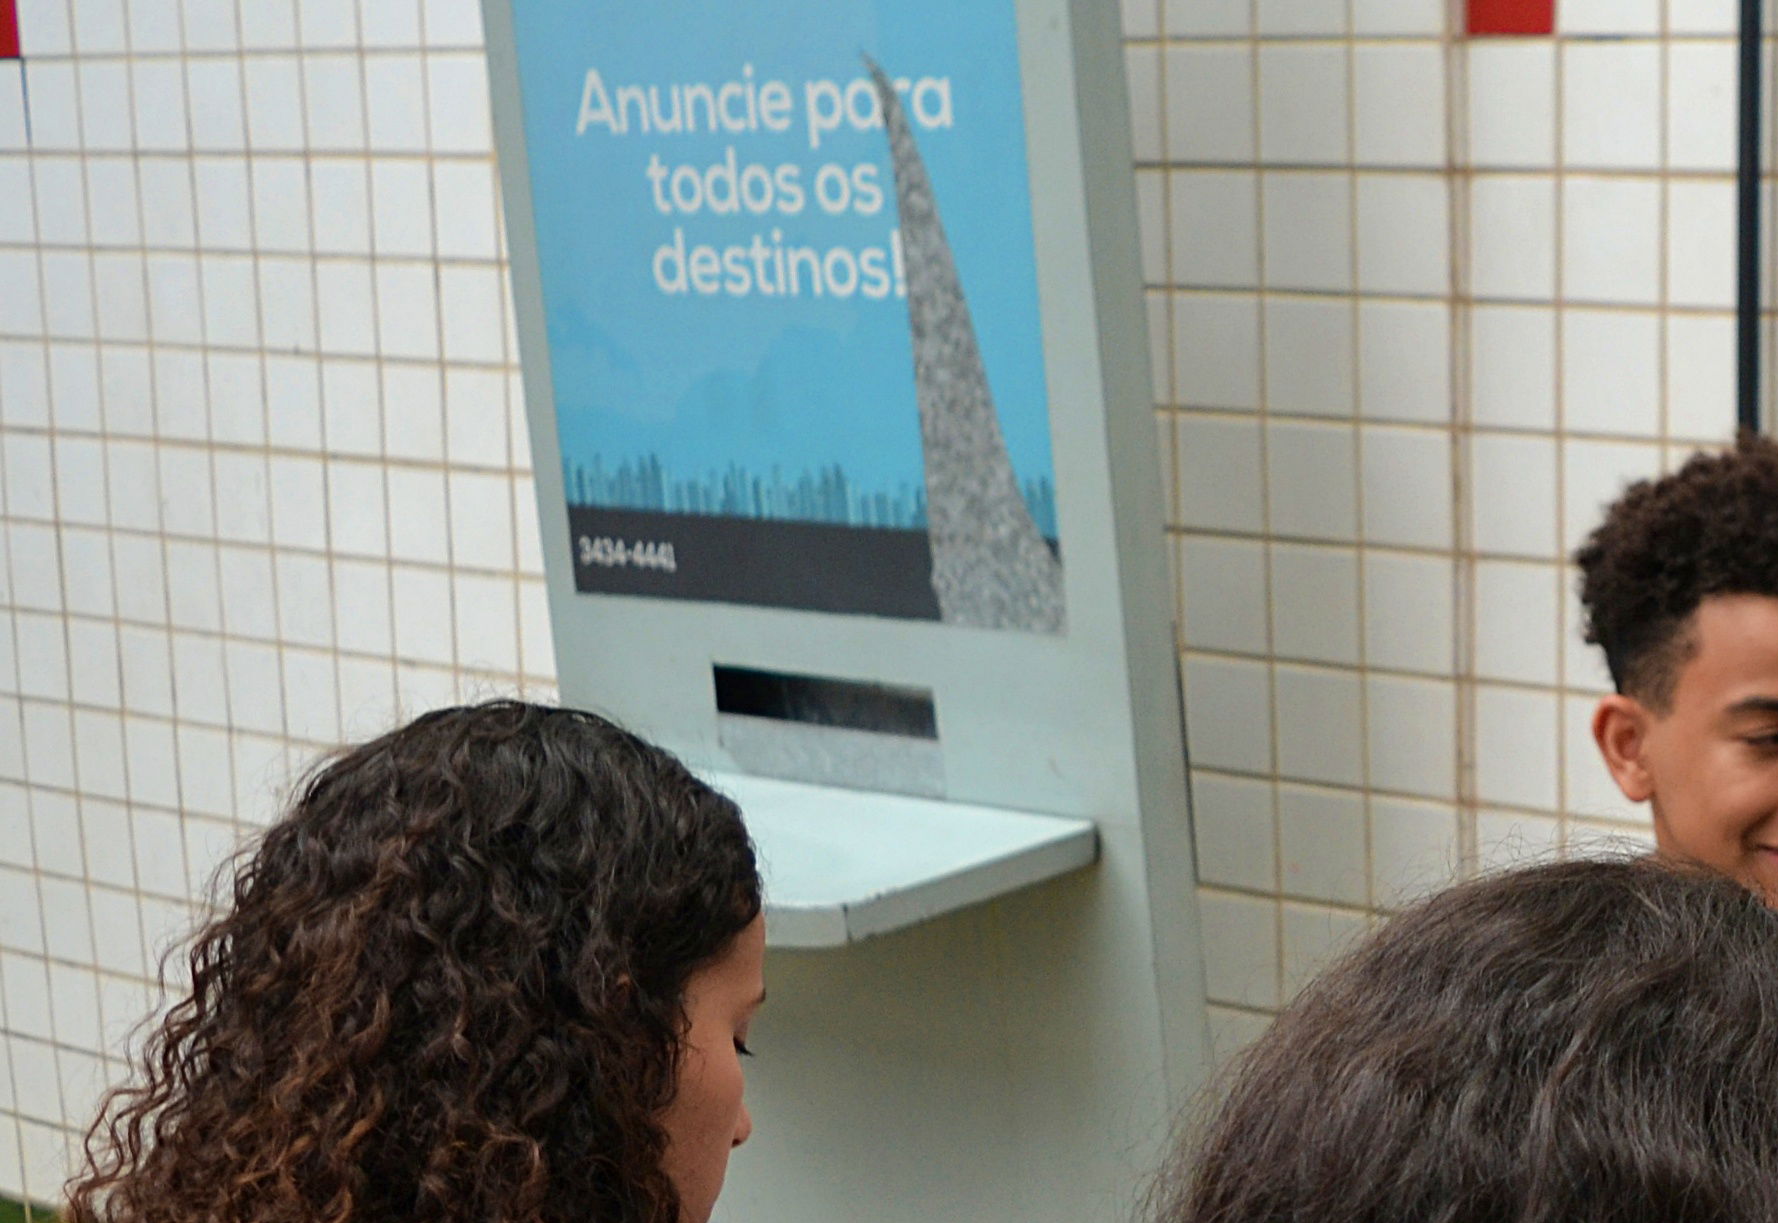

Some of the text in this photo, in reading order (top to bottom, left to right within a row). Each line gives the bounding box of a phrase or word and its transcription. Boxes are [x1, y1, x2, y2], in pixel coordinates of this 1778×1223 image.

[576, 62, 793, 136] Anuncie
[646, 146, 884, 215] todos os
[652, 227, 907, 298] destinos!
